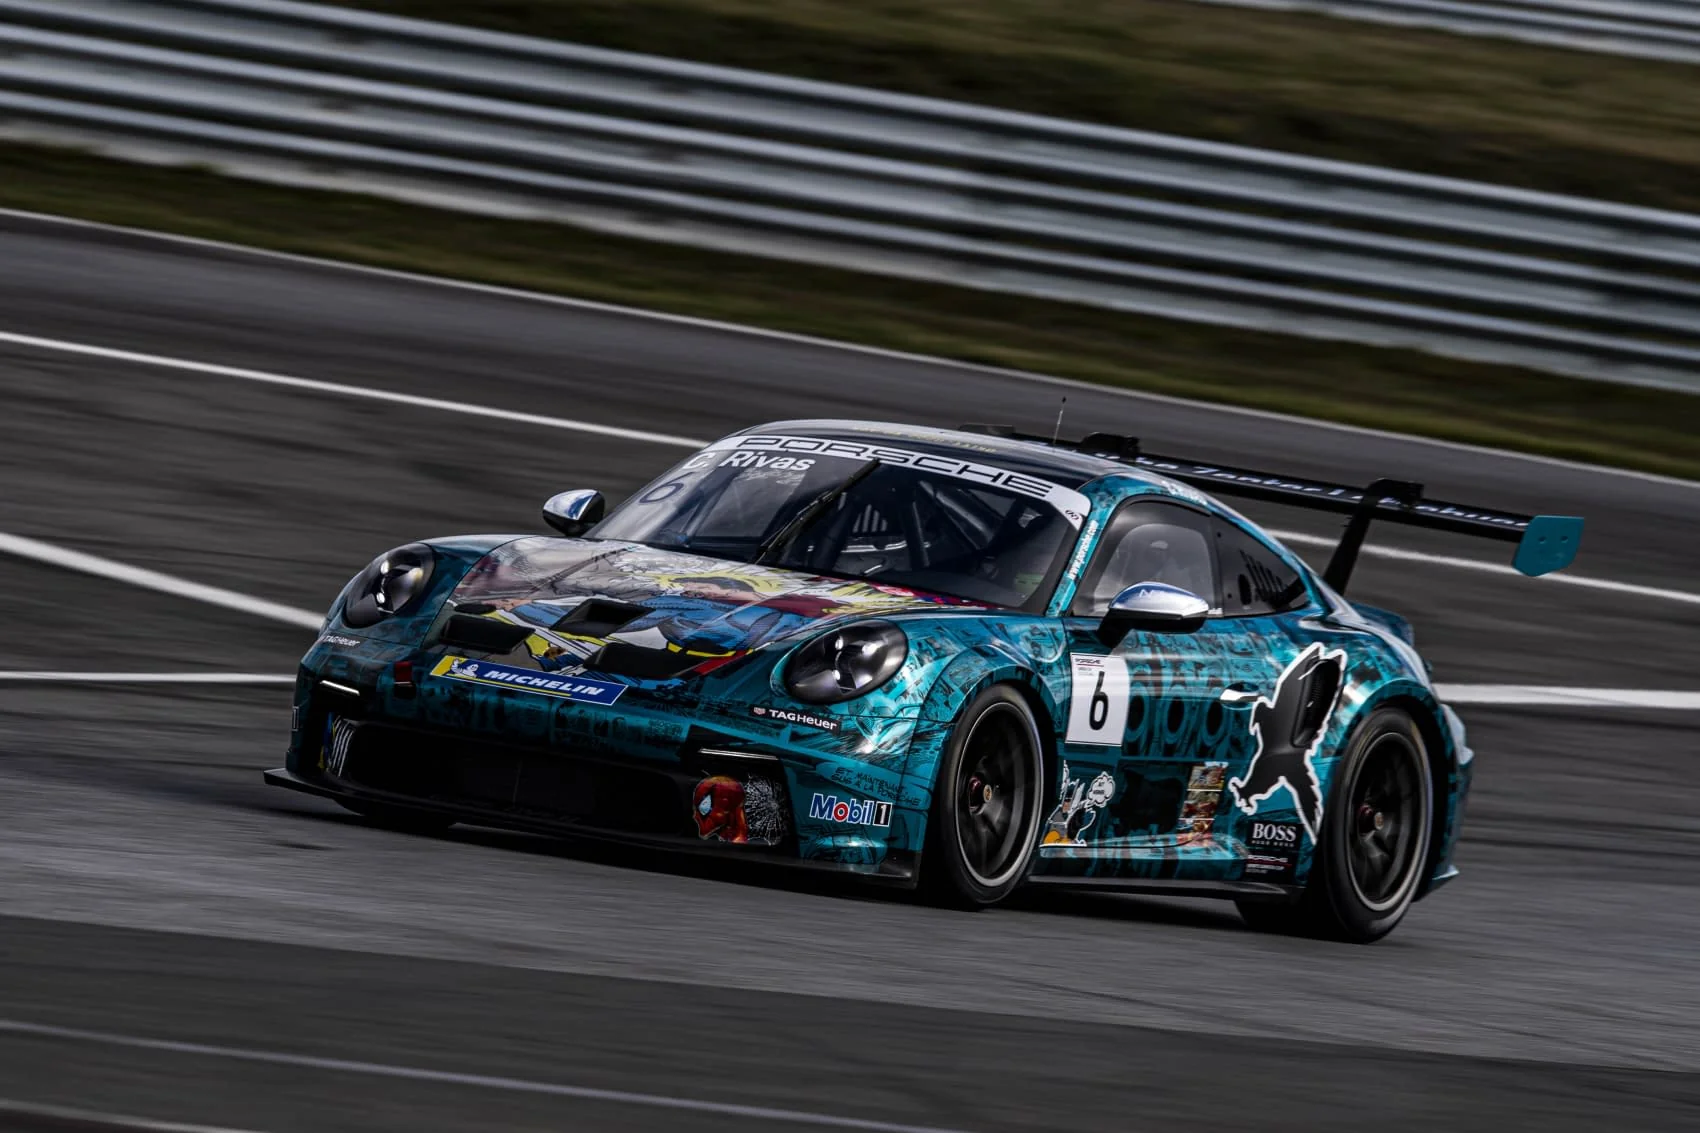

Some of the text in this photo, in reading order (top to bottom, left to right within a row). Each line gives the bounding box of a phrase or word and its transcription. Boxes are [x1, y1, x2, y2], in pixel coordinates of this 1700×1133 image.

[718, 451, 816, 471] Rivas
[738, 437, 1053, 498] PORSCHE
[483, 669, 606, 697] MICHELIN
[1089, 671, 1109, 730] 6
[809, 793, 875, 826] Mobil
[1251, 822, 1297, 842] BOSS
